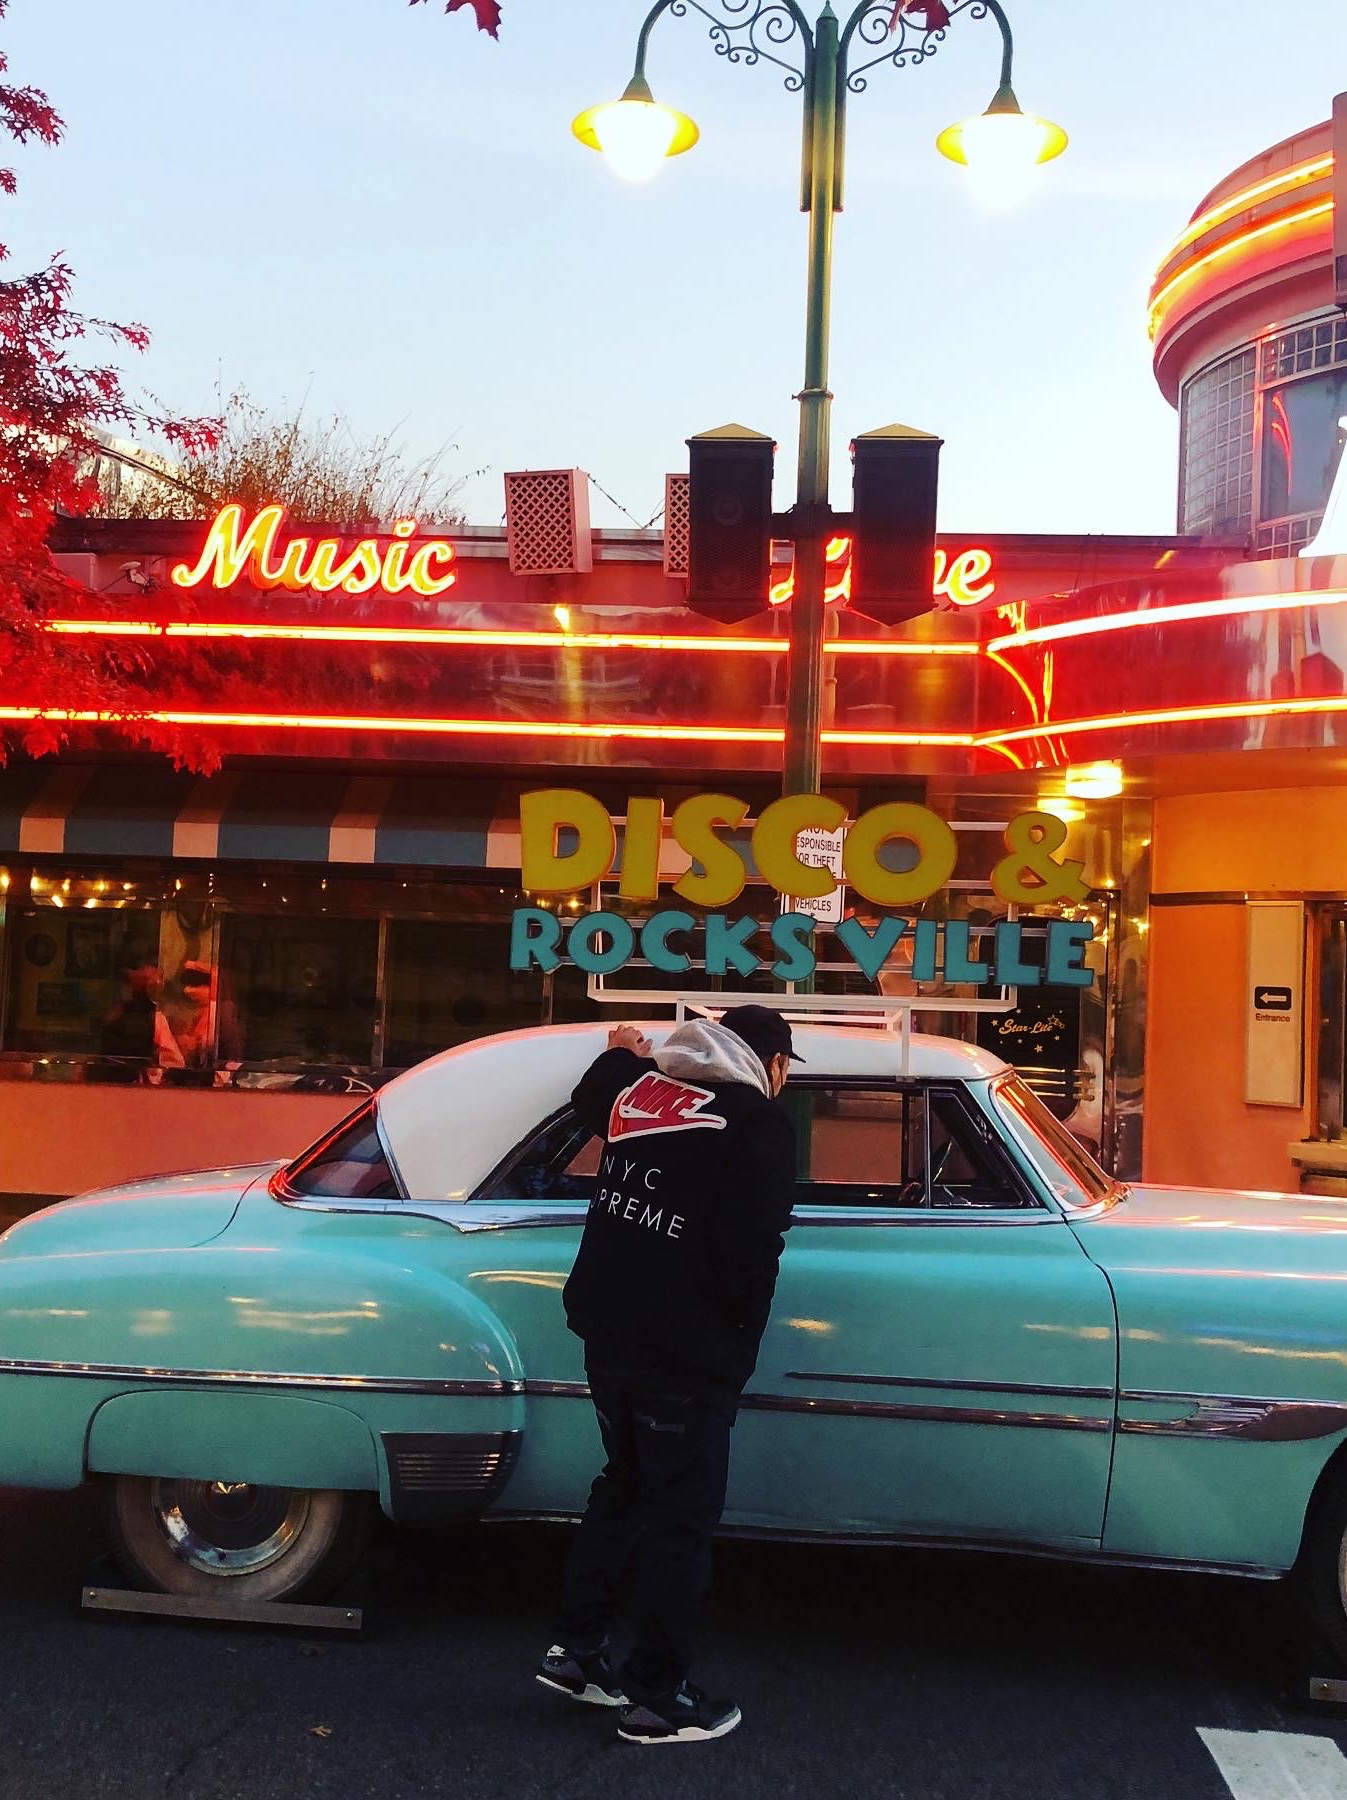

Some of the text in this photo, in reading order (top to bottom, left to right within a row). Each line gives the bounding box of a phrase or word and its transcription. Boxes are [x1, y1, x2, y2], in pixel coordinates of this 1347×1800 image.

[171, 502, 458, 597] Music
[519, 789, 1092, 907] DISCO &
[797, 837, 841, 853] SPONSIBLE
[797, 852, 836, 867] OR THEFT
[796, 898, 832, 912] VEHICLES
[1255, 1013, 1291, 1023] Entrance
[619, 1072, 716, 1121] NIKE
